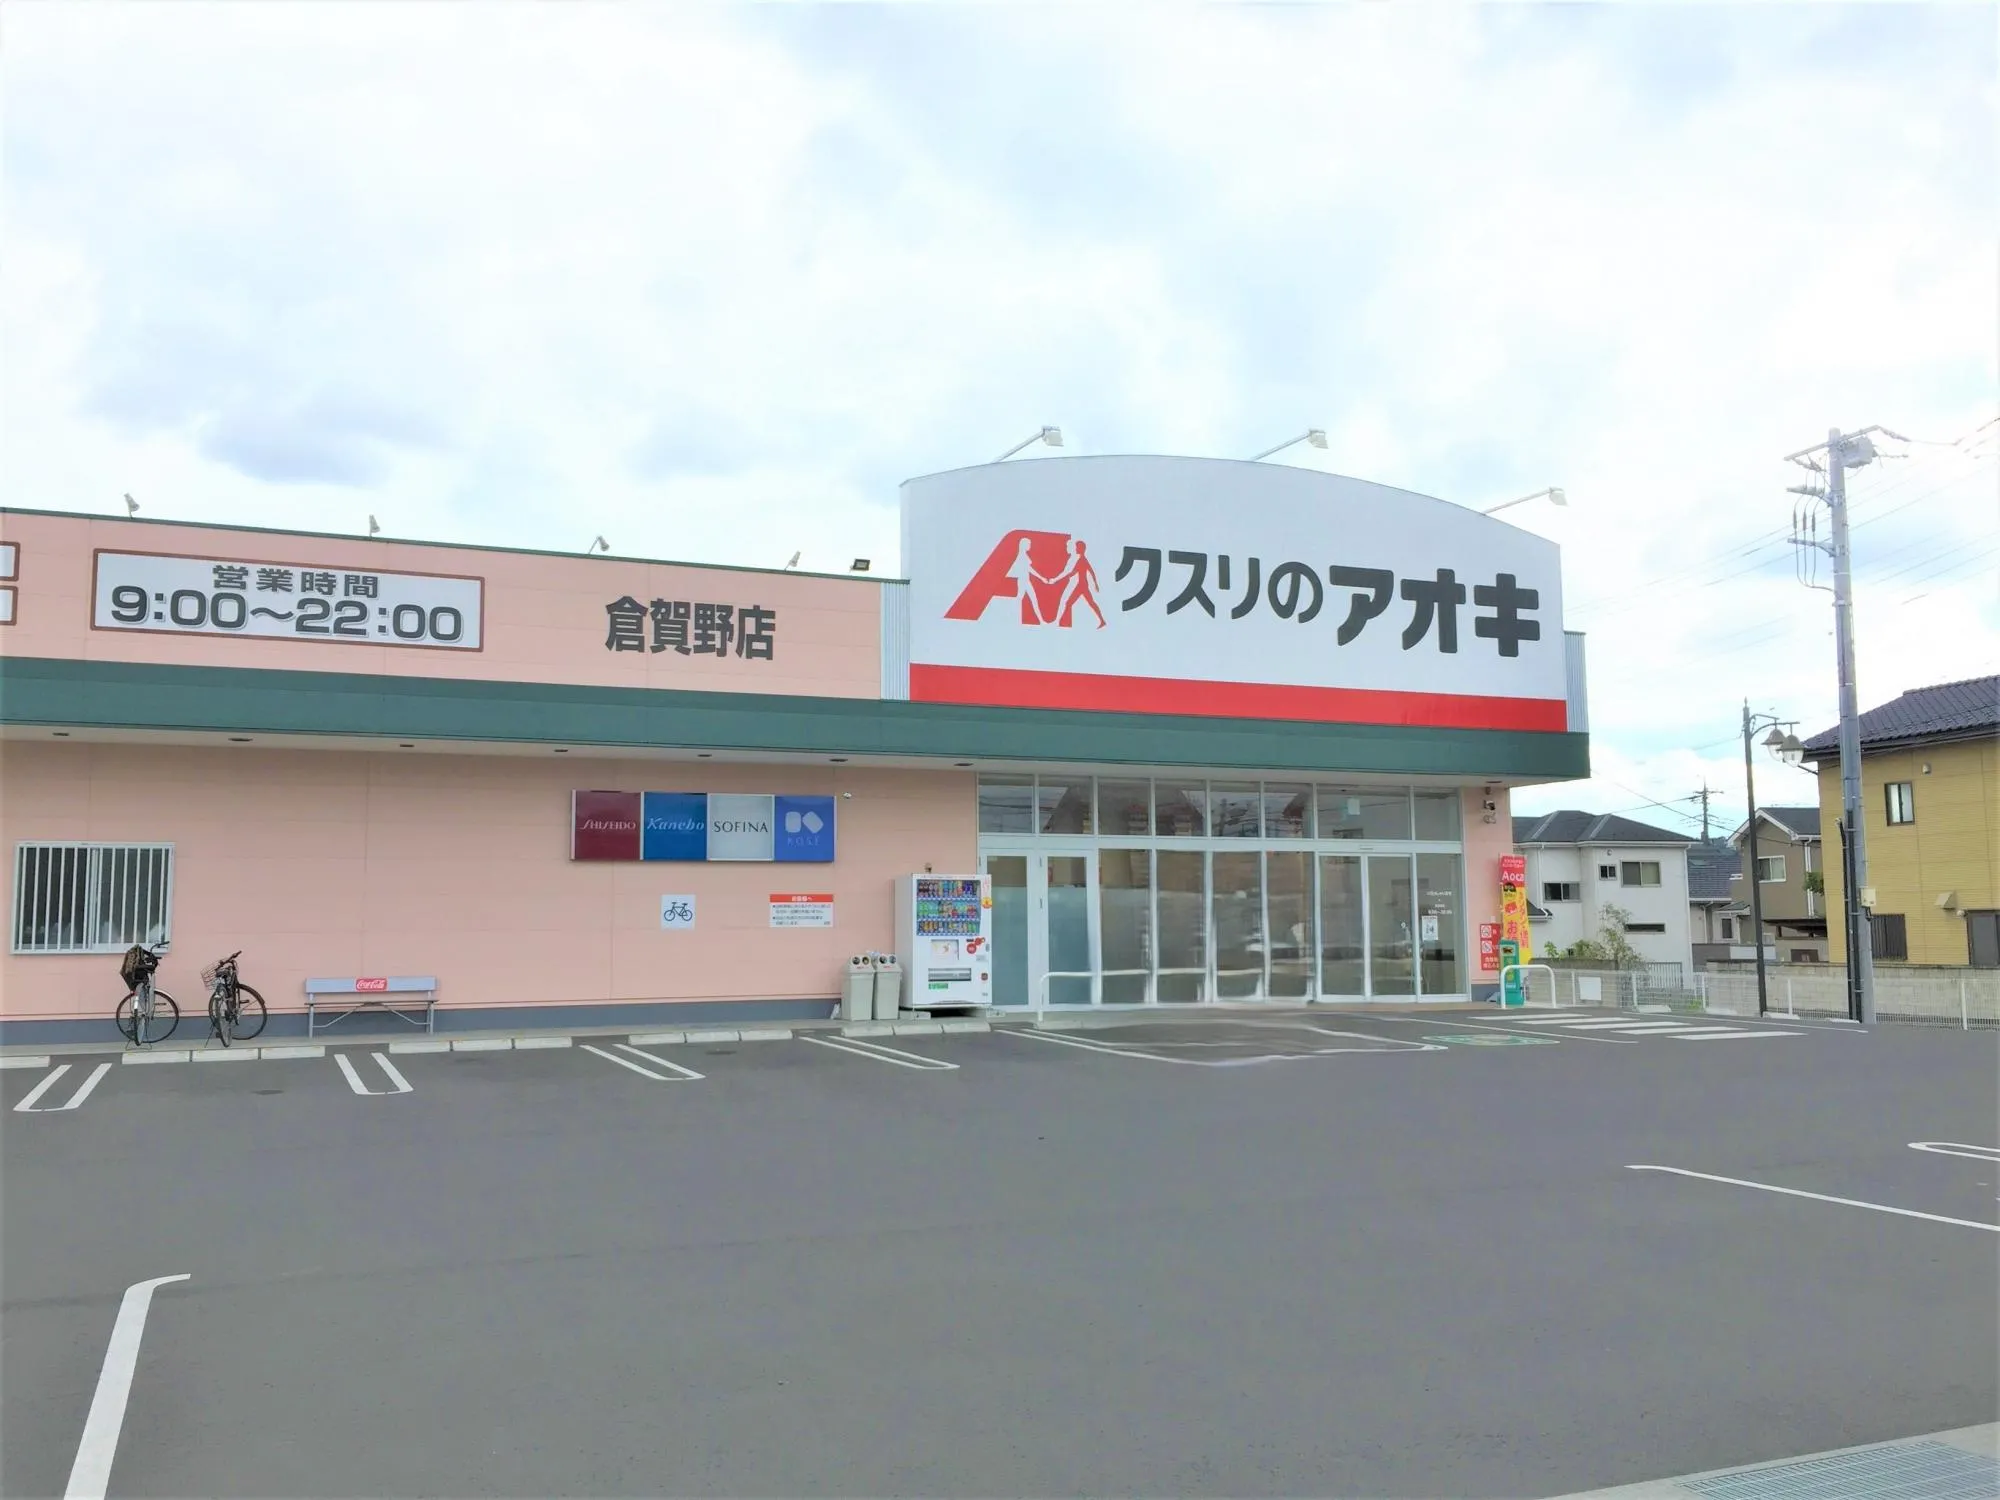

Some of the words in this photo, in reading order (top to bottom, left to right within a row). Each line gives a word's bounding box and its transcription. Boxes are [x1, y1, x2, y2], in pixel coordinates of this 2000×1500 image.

[213, 565, 378, 599] 営業時間
[1115, 545, 1541, 657] クスリのアオキ
[605, 595, 776, 661] 倉賀野店
[580, 819, 636, 830] SHISEIDO
[647, 818, 705, 830] Kanebo
[713, 820, 769, 833] SOFINA
